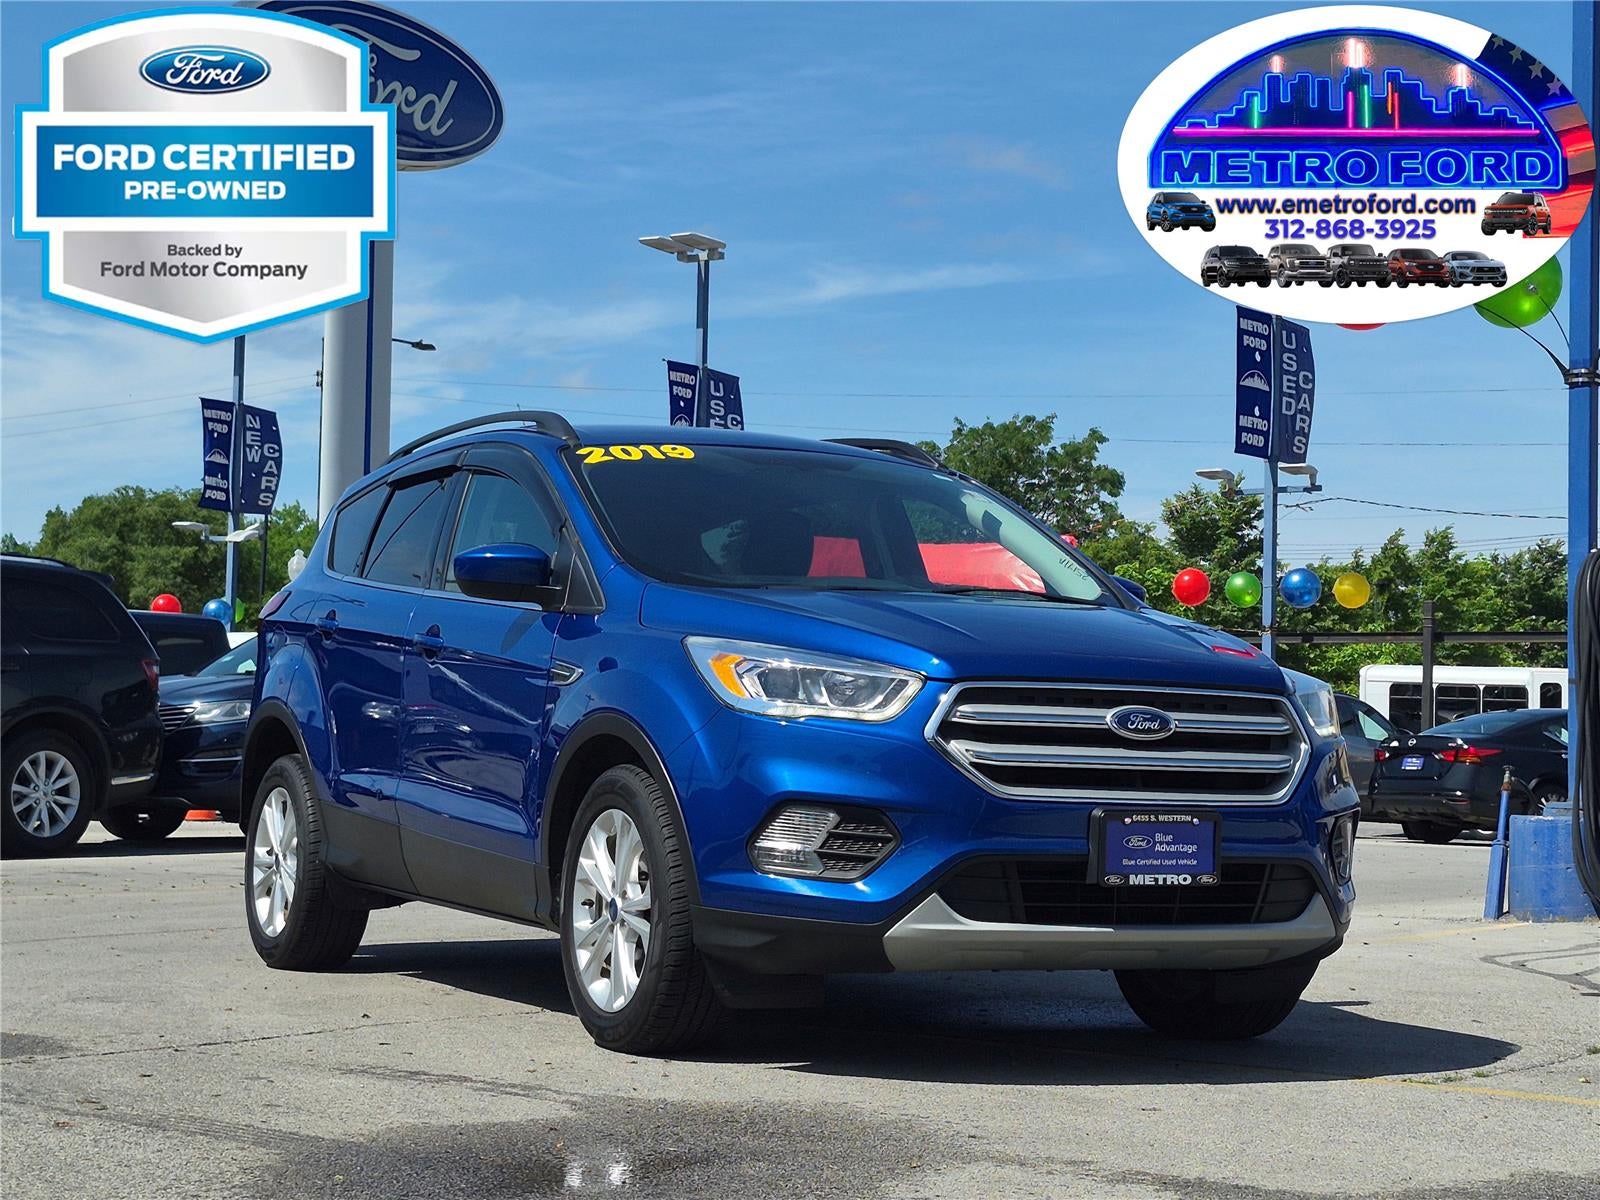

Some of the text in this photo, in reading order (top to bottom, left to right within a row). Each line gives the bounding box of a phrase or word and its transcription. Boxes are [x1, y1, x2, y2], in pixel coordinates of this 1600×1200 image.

[1239, 317, 1270, 336] METRO
[1242, 334, 1267, 351] FORD
[669, 370, 696, 385] METRO
[1281, 330, 1298, 417] USED
[672, 385, 693, 399] FORD
[203, 408, 232, 422] METRO
[1293, 371, 1313, 455] CARS
[207, 421, 229, 434] FORD
[1239, 415, 1269, 432] METRO
[245, 414, 262, 463] NEW
[1241, 432, 1265, 448] FORD
[575, 444, 695, 464] 2019
[258, 443, 280, 506] CARS
[1127, 712, 1161, 731] Ford
[1158, 814, 1192, 822] WESTERN
[1155, 832, 1174, 842] Blue
[1154, 843, 1198, 854] Advantage
[1122, 858, 1198, 866] Blue Certified Used Vehicle
[1128, 874, 1192, 885] METRO
